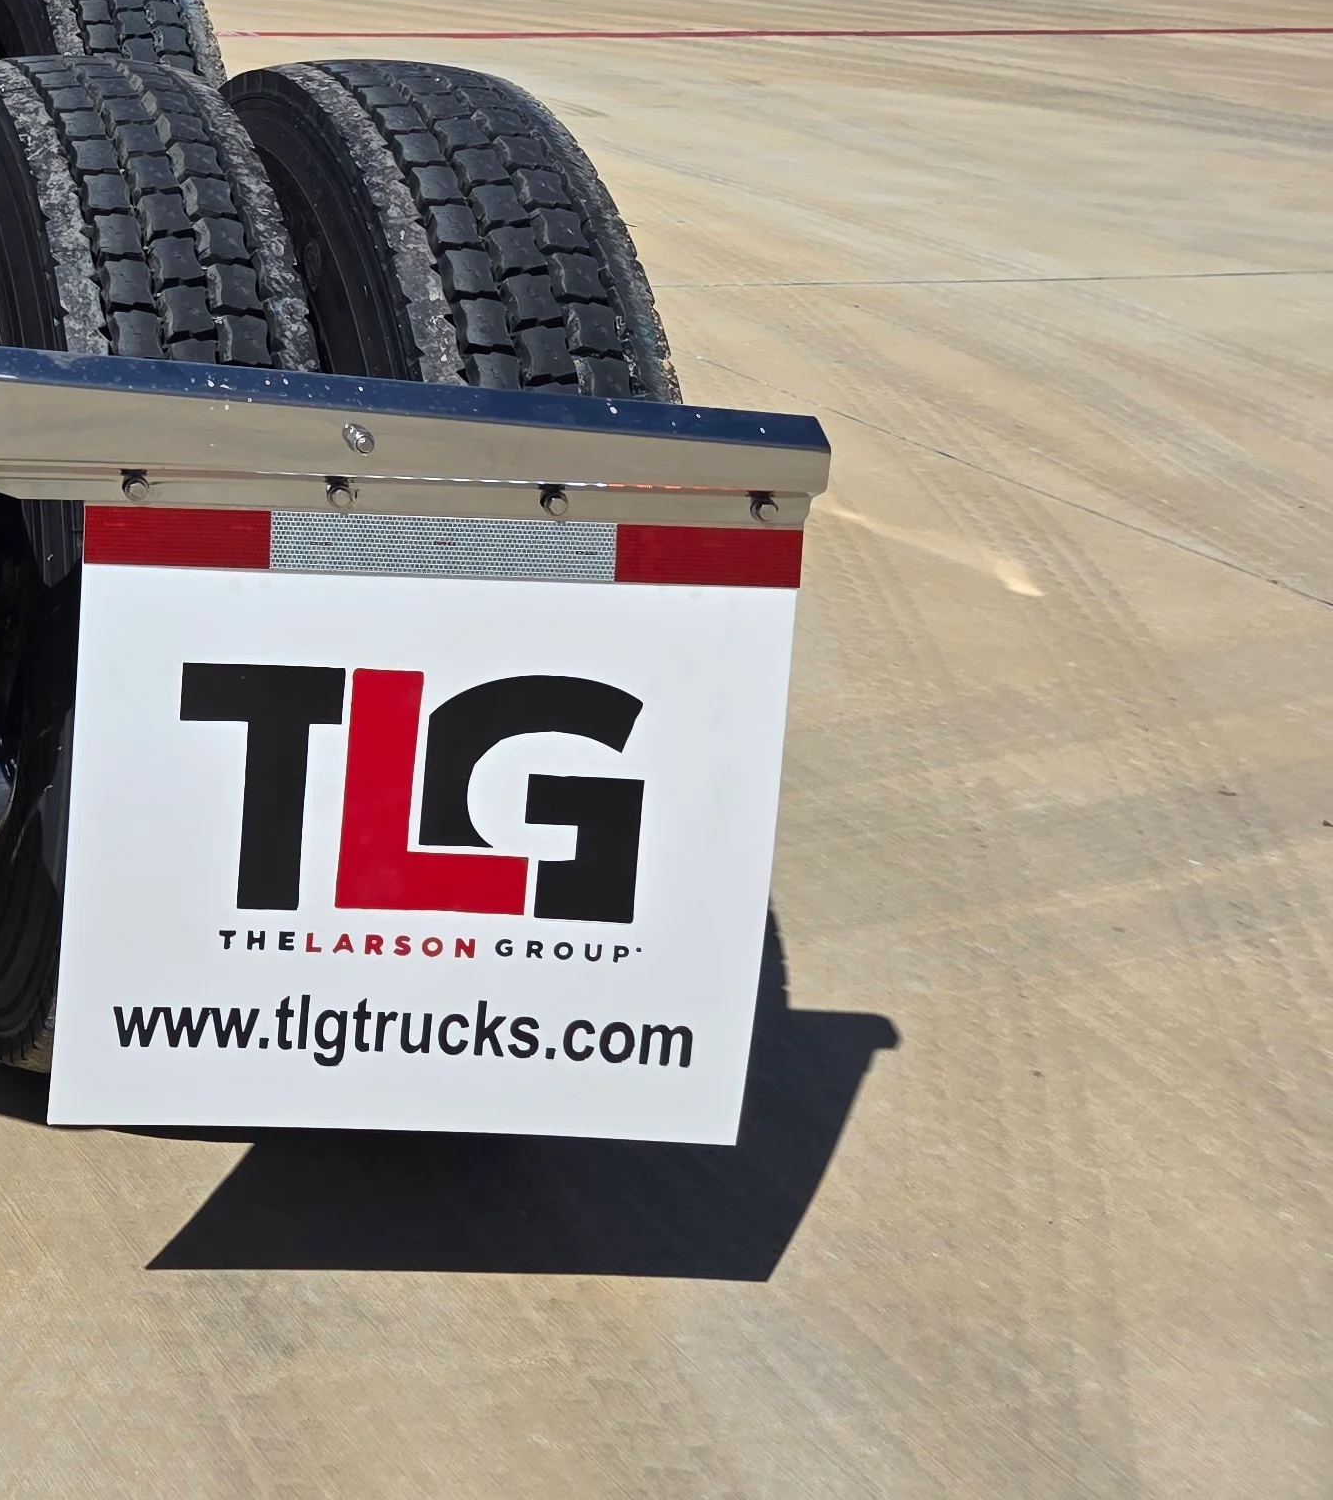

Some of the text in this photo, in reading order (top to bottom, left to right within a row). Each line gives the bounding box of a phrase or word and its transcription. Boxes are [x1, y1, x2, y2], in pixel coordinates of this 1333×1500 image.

[180, 663, 644, 923] TLG
[495, 939, 630, 963] GROUP
[114, 995, 693, 1069] www.tlgtrucks.com
